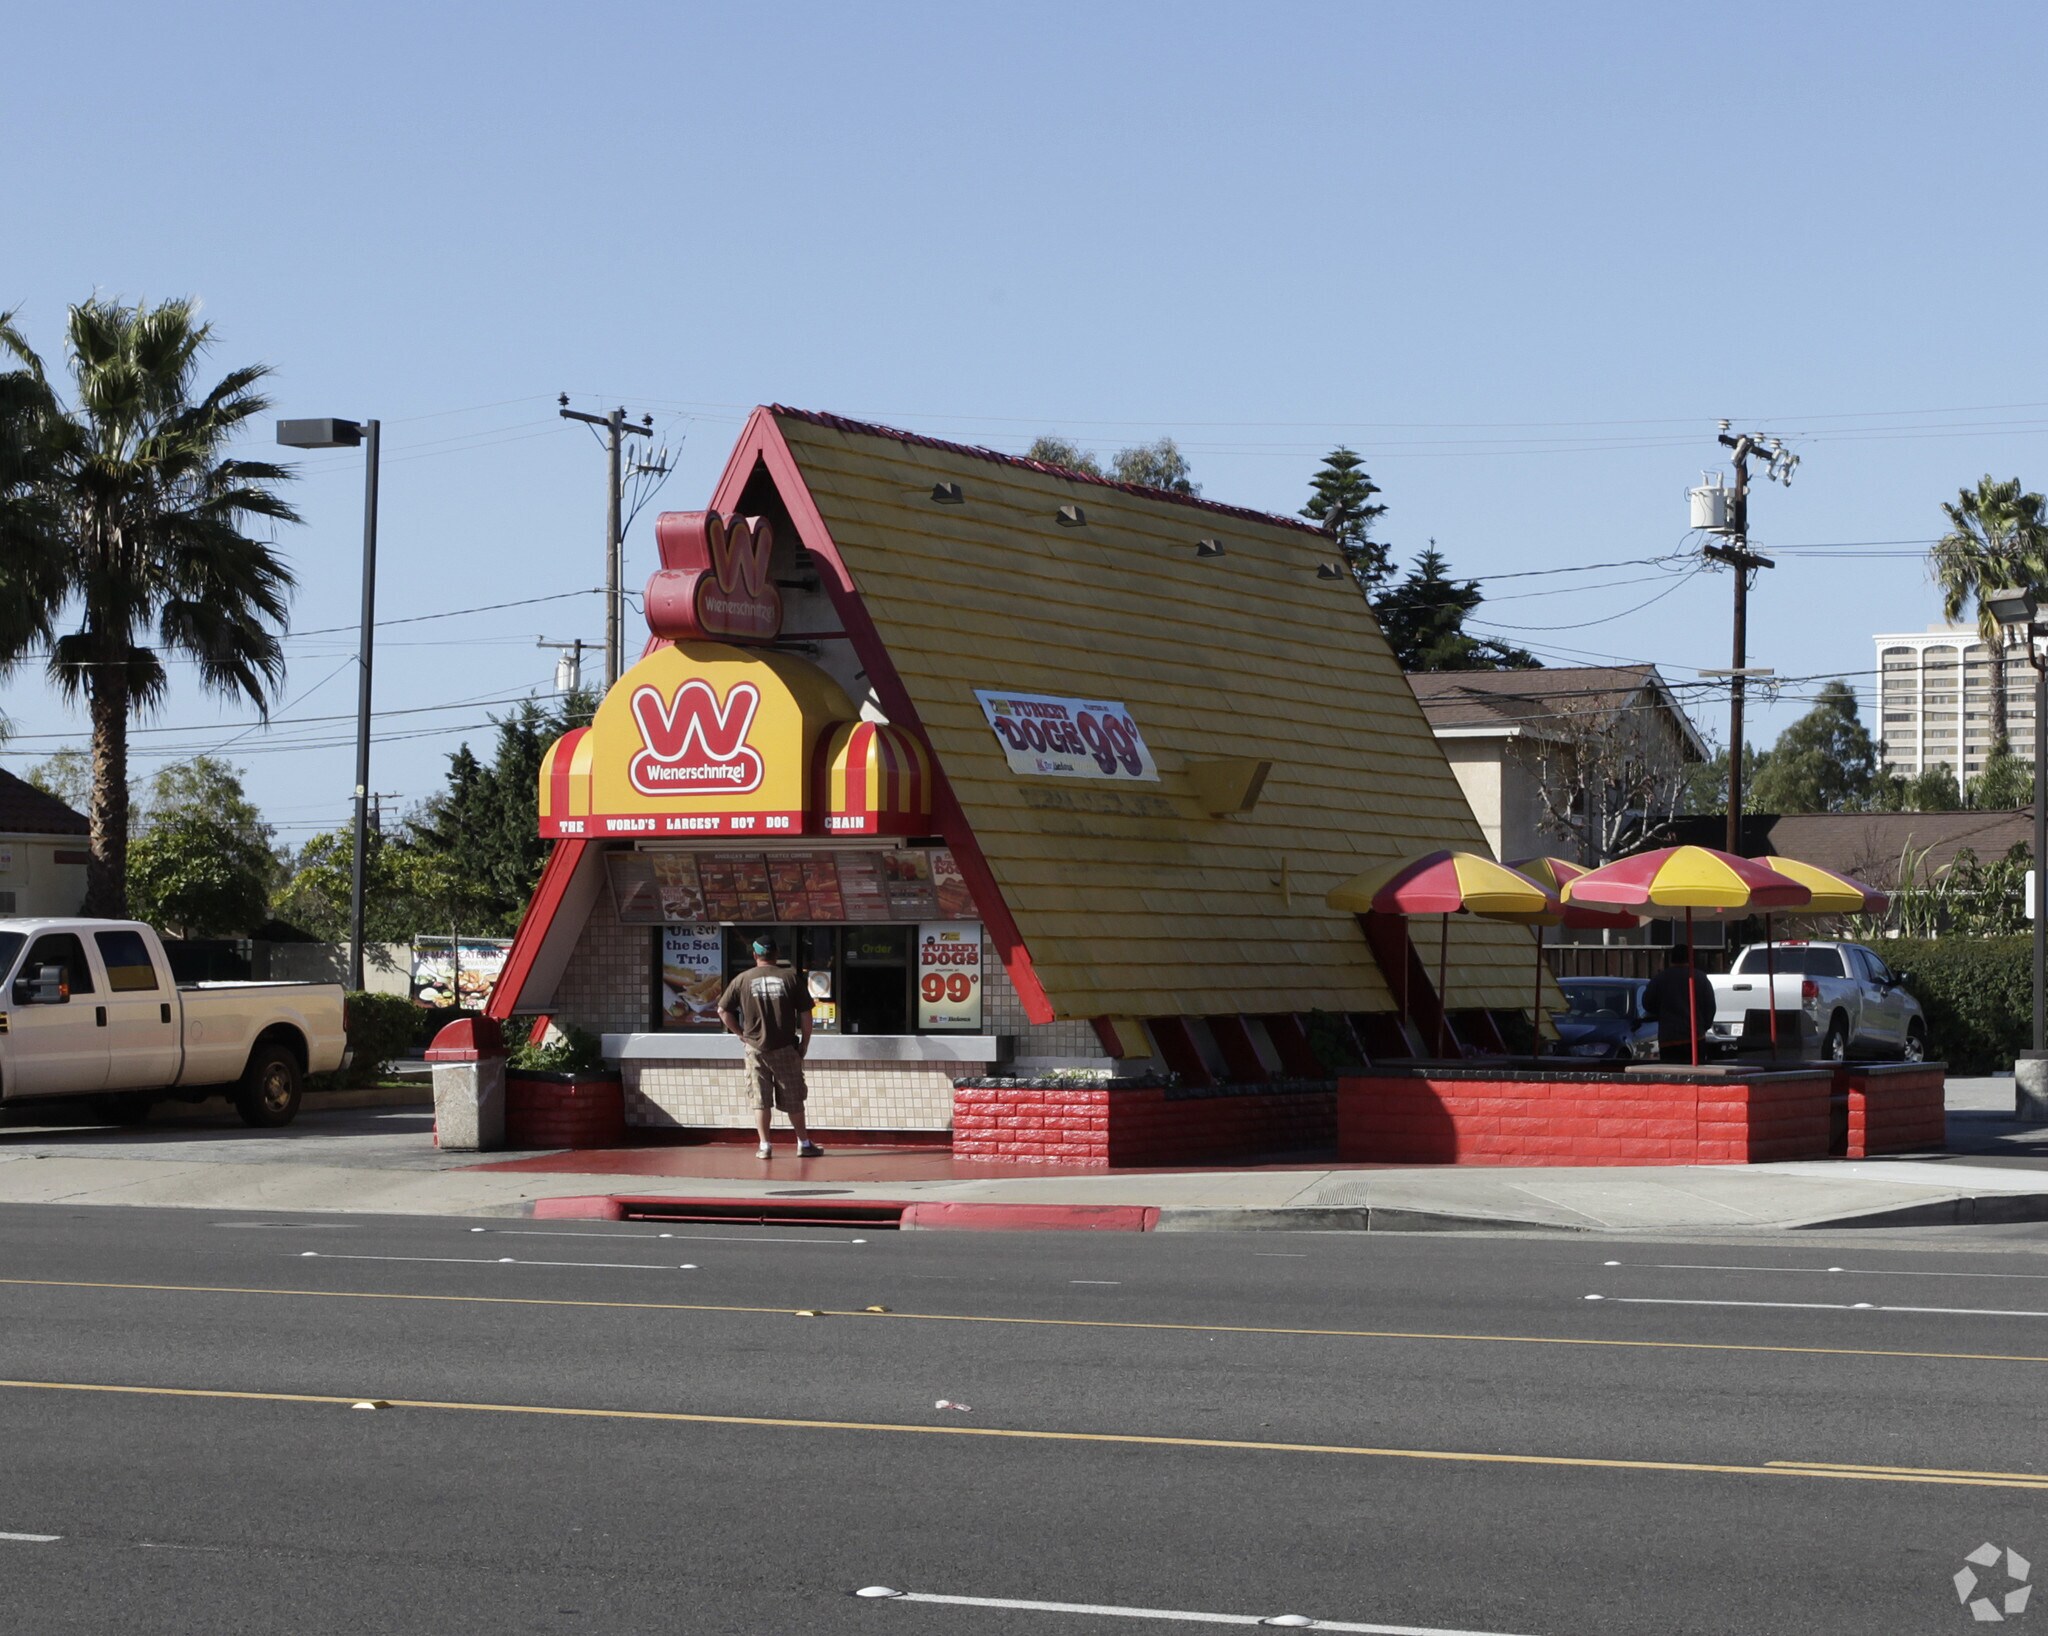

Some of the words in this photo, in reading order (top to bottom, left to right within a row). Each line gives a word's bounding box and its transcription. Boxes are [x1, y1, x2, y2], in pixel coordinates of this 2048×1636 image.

[1007, 700, 1070, 720] TURKEY
[634, 683, 757, 761] W
[995, 716, 1087, 755] DOGS
[646, 762, 745, 784] Wienerschnitzel
[559, 820, 585, 833] THE
[606, 818, 656, 831] WORLD'S
[666, 817, 720, 830] LARGEST
[730, 816, 756, 829] HOT
[766, 816, 789, 829] DOG
[824, 816, 865, 829] CHAIN
[666, 940, 690, 951] the
[693, 940, 720, 951] Sea
[922, 943, 978, 952] TURKEY
[459, 950, 504, 959] CATERING
[676, 954, 709, 964] Trio
[921, 952, 979, 966] DOGS
